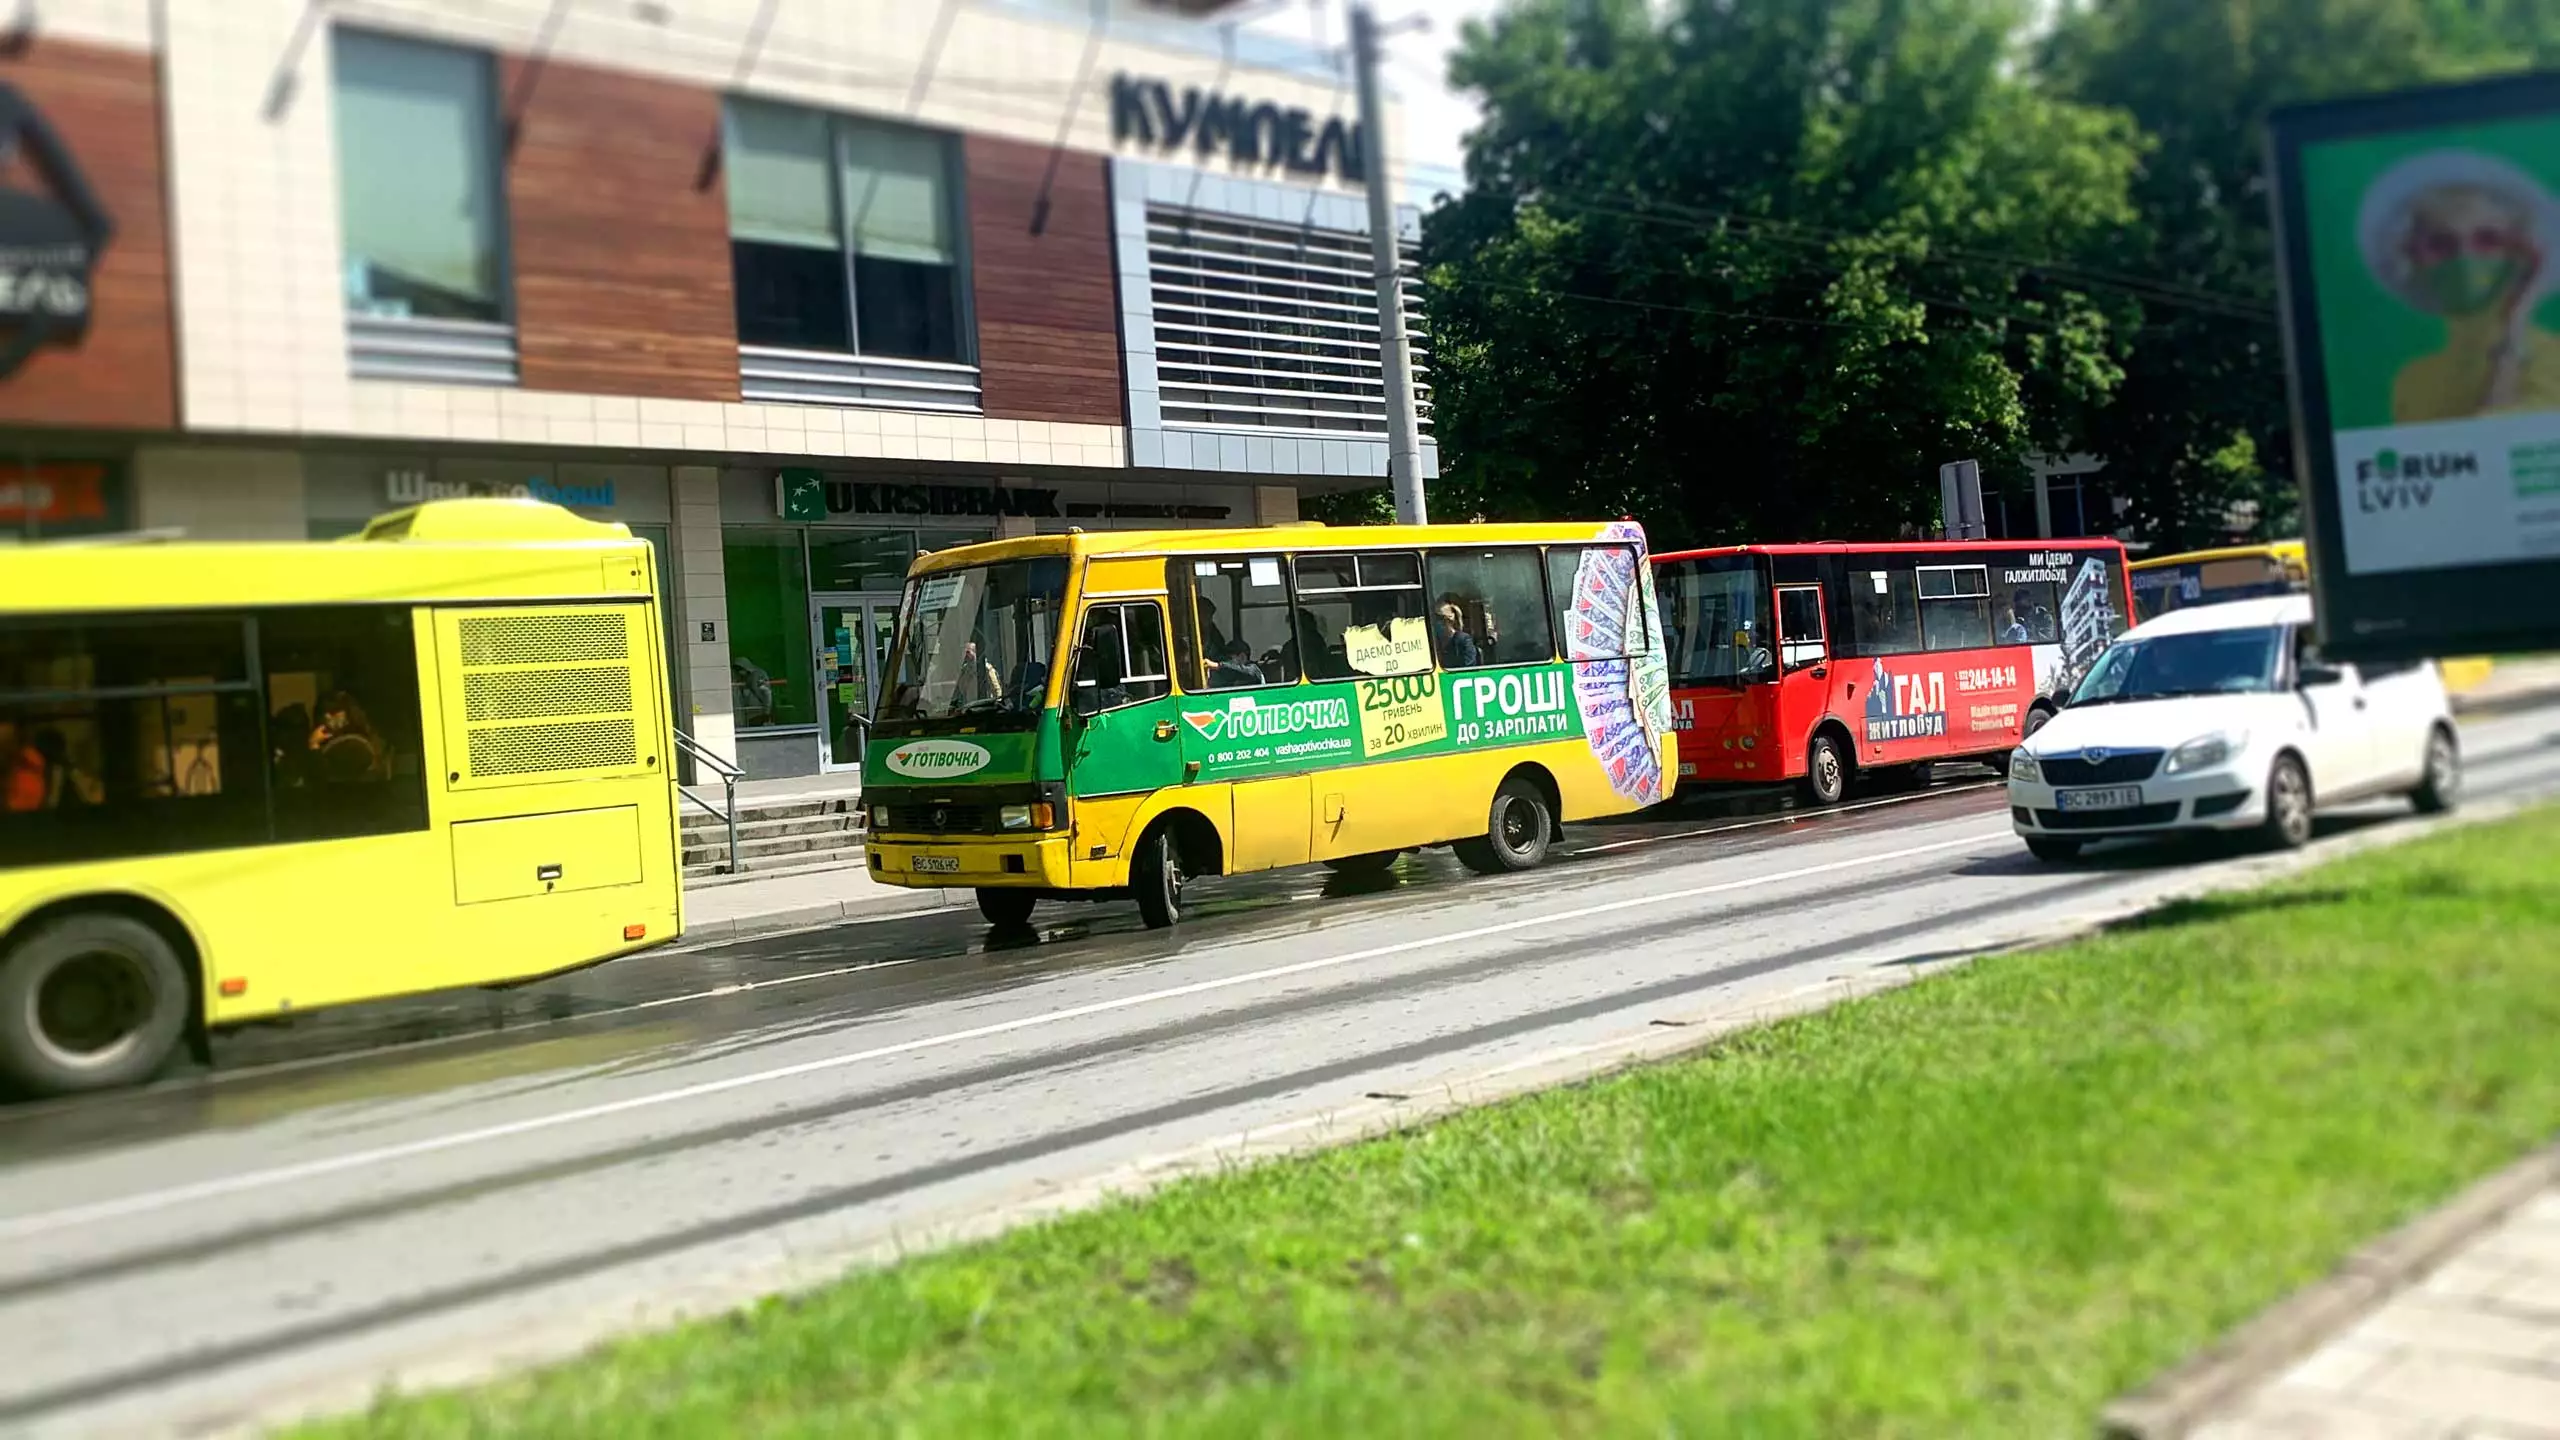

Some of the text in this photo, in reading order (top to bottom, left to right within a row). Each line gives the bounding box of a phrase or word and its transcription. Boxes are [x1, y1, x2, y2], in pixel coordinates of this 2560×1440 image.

[825, 481, 1061, 517] UKRSIBBANK
[2358, 481, 2433, 514] LVIV
[2029, 550, 2073, 568] МИ ЇДЕМО
[2004, 568, 2067, 584] ГАЛЖИТЛОБУД
[1356, 639, 1423, 663] ДАЄМО ВСІМ!
[1385, 660, 1399, 673] ДО
[1968, 665, 2016, 691] 244-14-14
[1363, 674, 1435, 711] 25000
[1452, 671, 1566, 720] ГРОШІ
[1894, 672, 1946, 716] ГАЛ
[1228, 698, 1349, 738] ГОТІВОЧКА
[1383, 703, 1422, 721] ГРИВЕНЬ
[1671, 699, 1695, 719] АЛ
[1384, 723, 1405, 746] 20
[1457, 713, 1568, 745] ДО ЗАРПЛАТИ
[1868, 714, 1944, 740] ЖИТЛОБУД
[912, 751, 980, 768] ГОТІВОЧКА
[1208, 738, 1351, 763] 0 800 202 404 vashagotivochka.ua
